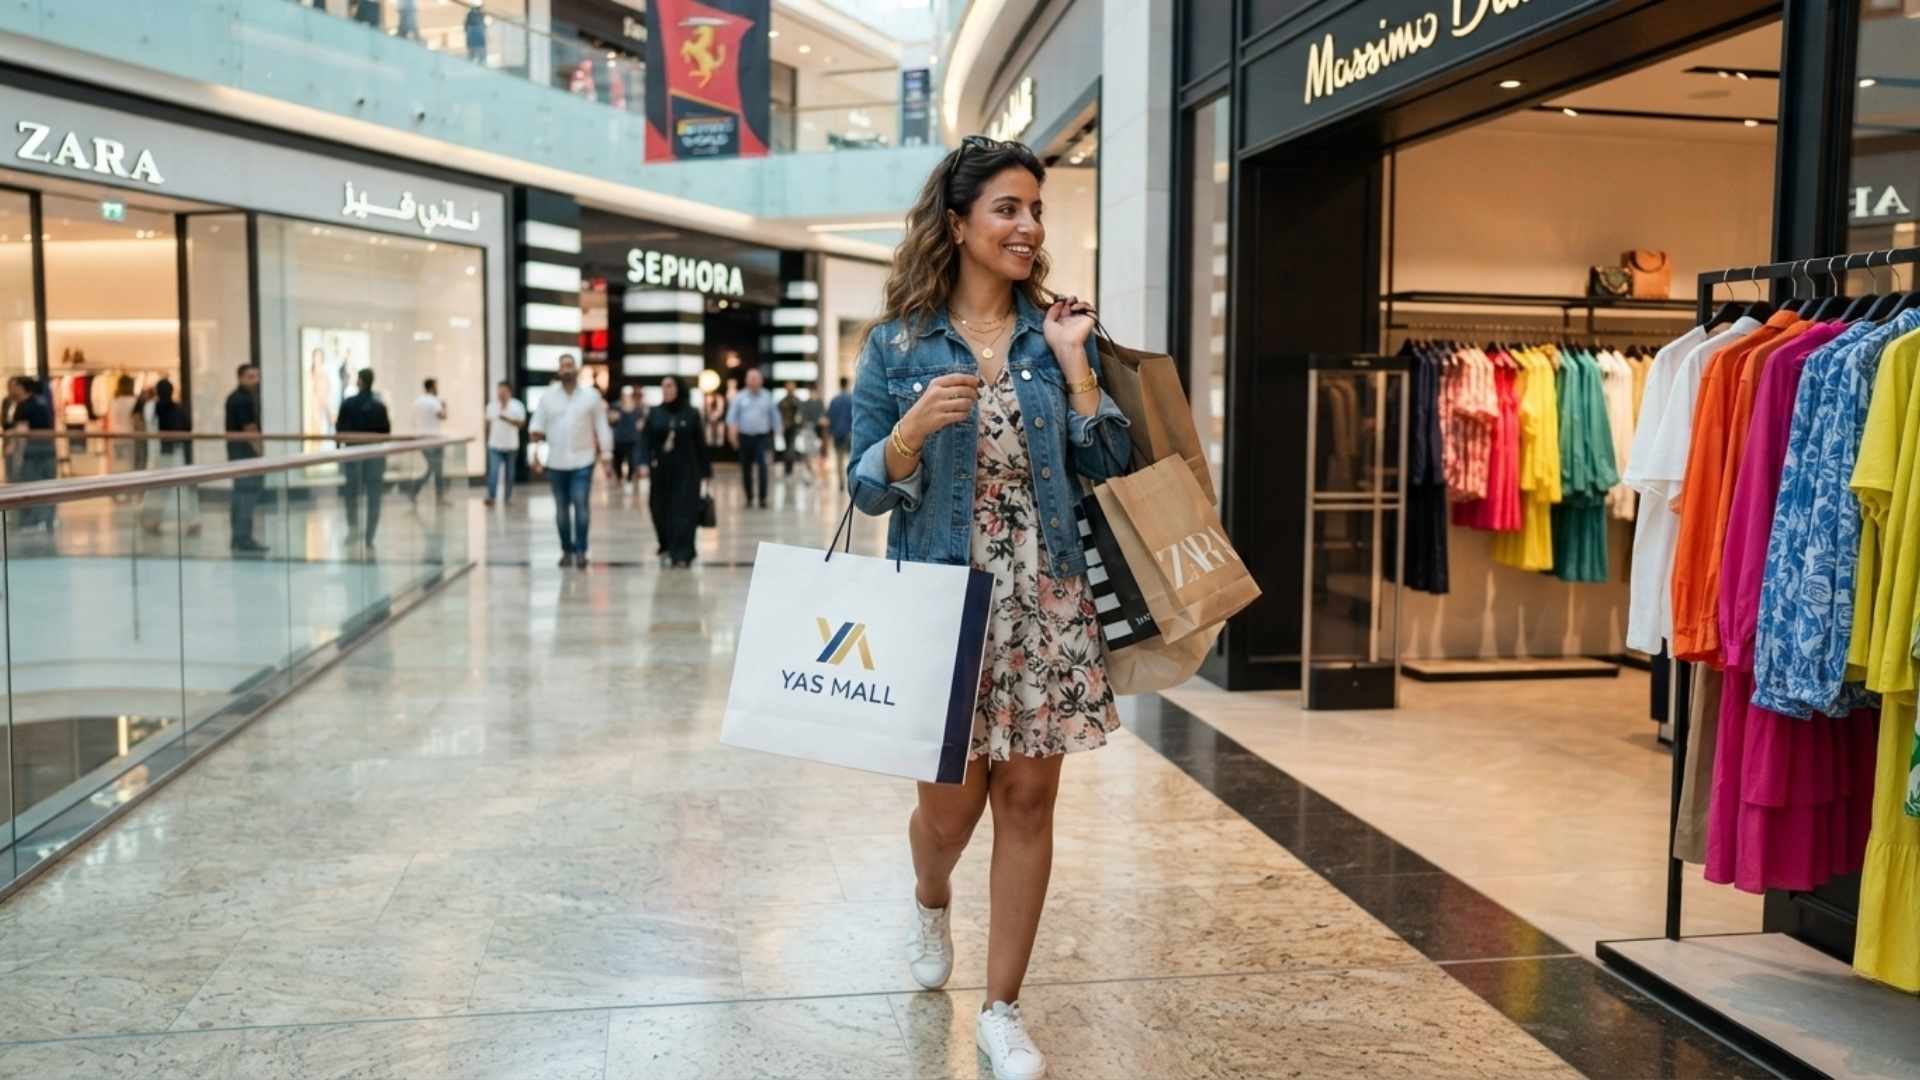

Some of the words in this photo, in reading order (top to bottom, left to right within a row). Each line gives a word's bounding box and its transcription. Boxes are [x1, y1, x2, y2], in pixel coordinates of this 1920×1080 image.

[1304, 12, 1439, 105] Massimo
[17, 120, 165, 185] ZARA
[626, 248, 744, 296] SEPHORA
[781, 669, 825, 694] YAS
[830, 677, 896, 706] MALL
